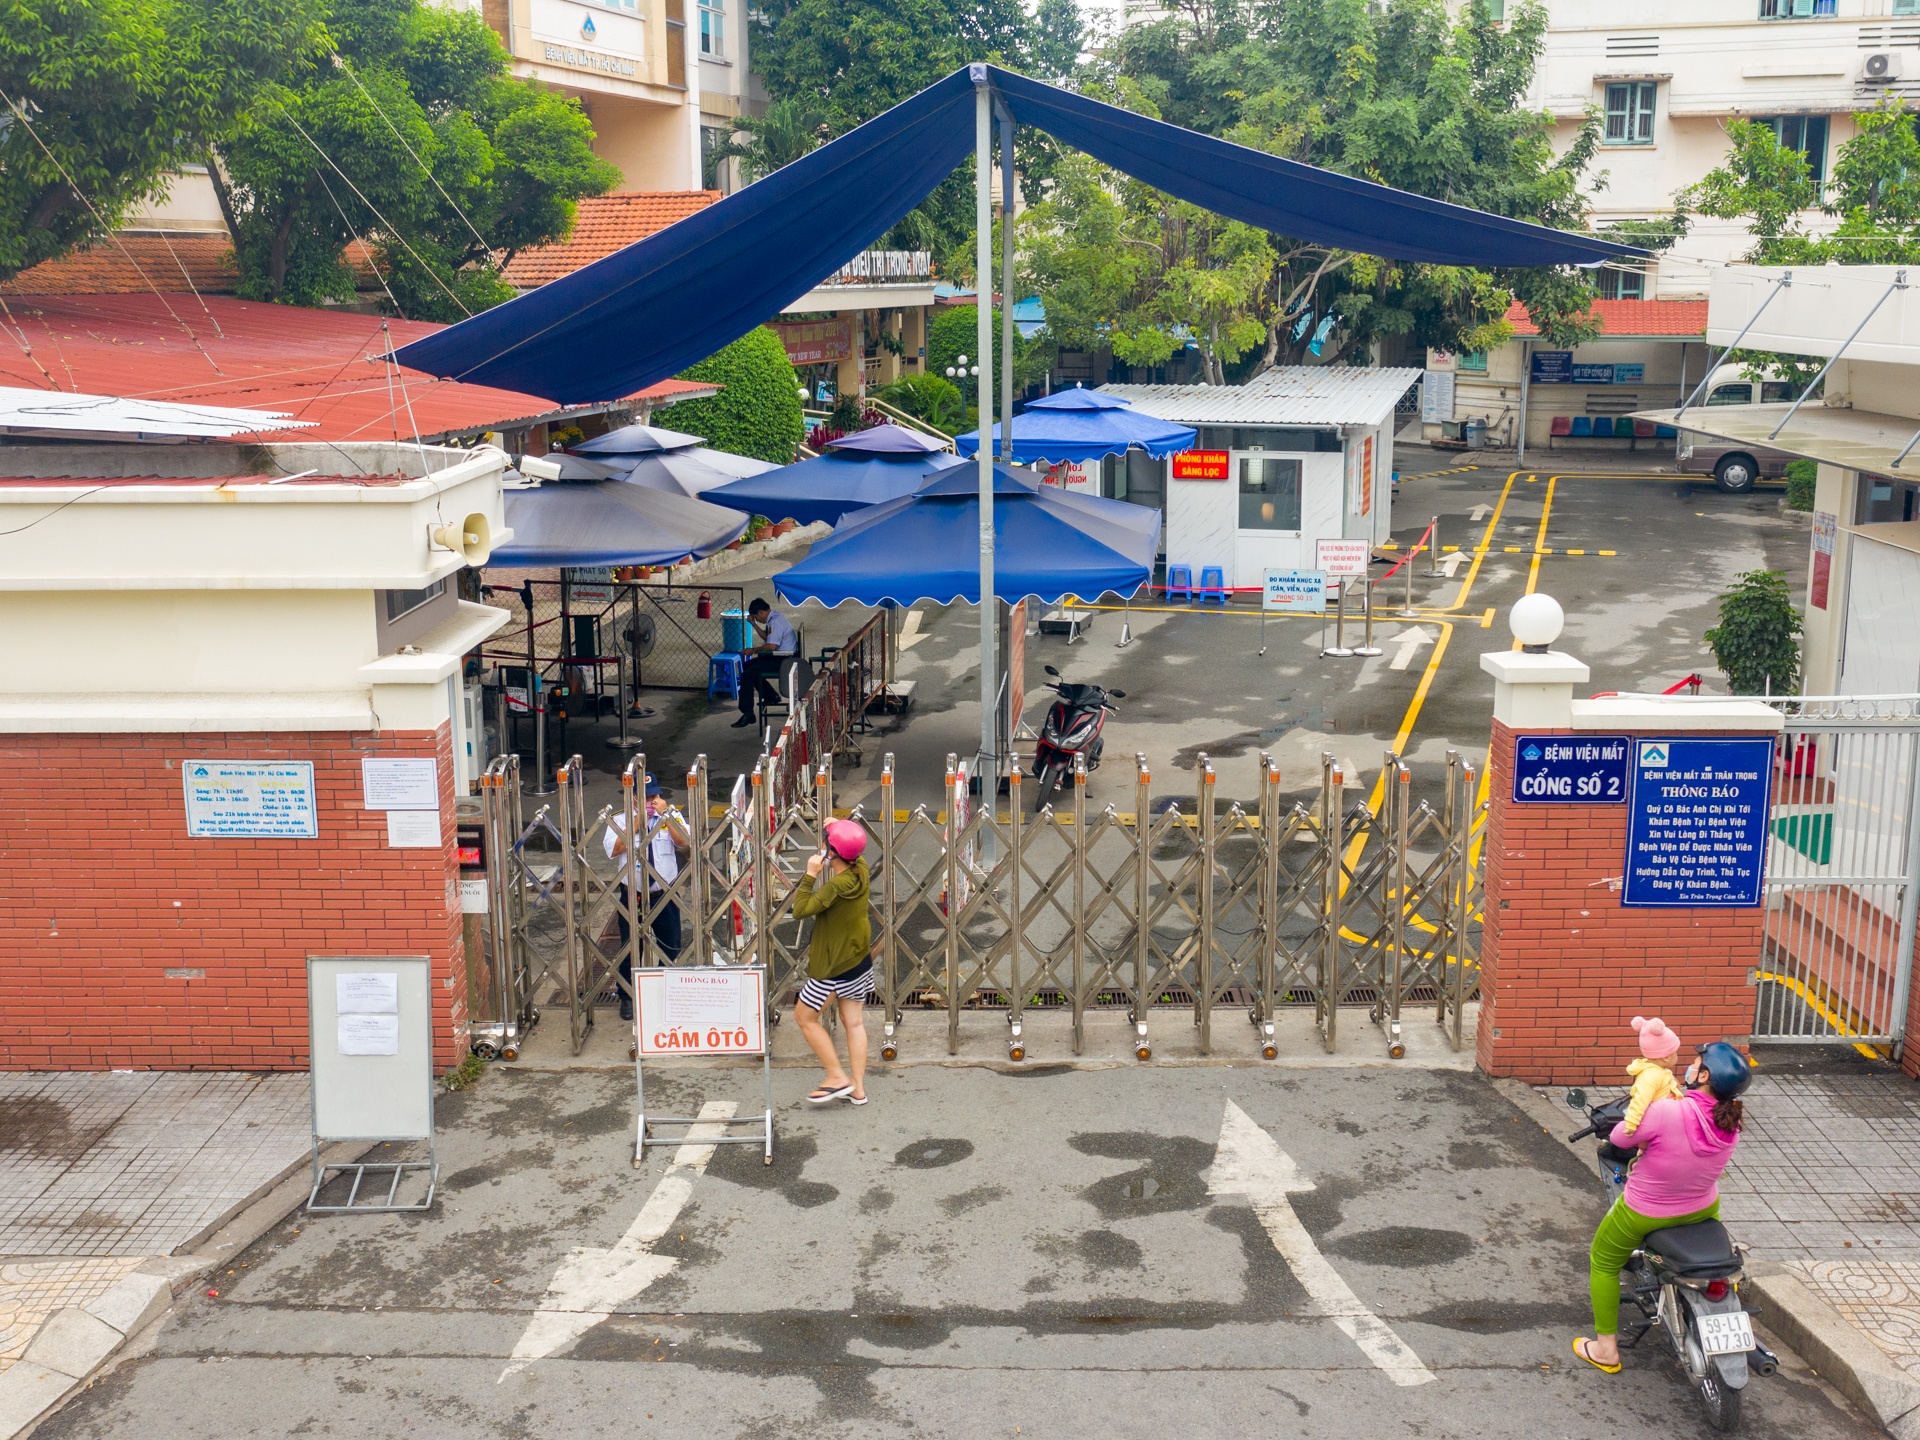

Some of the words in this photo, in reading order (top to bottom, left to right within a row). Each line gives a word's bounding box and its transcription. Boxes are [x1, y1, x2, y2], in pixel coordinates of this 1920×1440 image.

[826, 321, 838, 337] 2021
[797, 351, 808, 361] NEW
[809, 350, 822, 360] YEAR
[1176, 453, 1202, 463] PHÒNG
[1203, 454, 1226, 464] KHÁM
[1182, 466, 1202, 476] SÀNG
[1204, 468, 1220, 477] LỌC
[1544, 744, 1573, 762] BỆNH
[1576, 744, 1599, 762] VIỆN
[1602, 741, 1624, 760] MẮT
[1644, 770, 1663, 780] BỆNH
[1665, 770, 1681, 780] VIỆN
[1684, 769, 1699, 780] MẮT
[1715, 770, 1732, 780] TRÂN
[1735, 772, 1758, 781] TRỌNG
[1522, 768, 1572, 796] CỔNG
[1576, 770, 1604, 796] SỐ
[1607, 777, 1620, 795] 2
[1661, 784, 1708, 798] THÔNG
[1711, 784, 1739, 798] BÁO
[1647, 805, 1661, 814] Quý
[1664, 805, 1674, 813] Cô
[1676, 805, 1690, 813] Bác
[1693, 805, 1706, 813] Anh
[1709, 805, 1721, 814] Chị
[1724, 805, 1736, 813] Khi
[1739, 805, 1750, 813] Tới
[1649, 818, 1670, 826] Khám
[1673, 818, 1691, 826] Bệnh
[1694, 818, 1706, 826] Tại
[1708, 818, 1727, 826] Bệnh
[1729, 818, 1746, 826] Viện
[1649, 830, 1661, 838] Xin
[1664, 830, 1676, 838] Vui
[1678, 830, 1696, 840] Lòng
[1699, 830, 1708, 838] Đi
[1735, 830, 1745, 838] Vô
[1639, 843, 1658, 852] Bệnh
[1660, 843, 1677, 852] Viện
[1680, 841, 1690, 851] Để
[1692, 843, 1711, 852] Được
[1714, 843, 1733, 851] Nhân
[1735, 843, 1752, 851] Viên
[1669, 855, 1679, 865] Vệ
[1699, 855, 1717, 864] Bệnh
[1720, 855, 1736, 864] Viện
[1680, 868, 1694, 877] Quy
[1737, 868, 1750, 877] Tục
[1653, 880, 1672, 890] Đăng
[1674, 880, 1684, 890] Ký
[1687, 880, 1707, 888] Khám
[679, 976, 709, 984] THÔNG
[710, 976, 728, 984] BÁO
[654, 1026, 699, 1048] CẤM
[707, 1026, 748, 1047] ÔTÔ
[1705, 1316, 1741, 1334] 59-L1
[1705, 1332, 1751, 1352] 117.30
